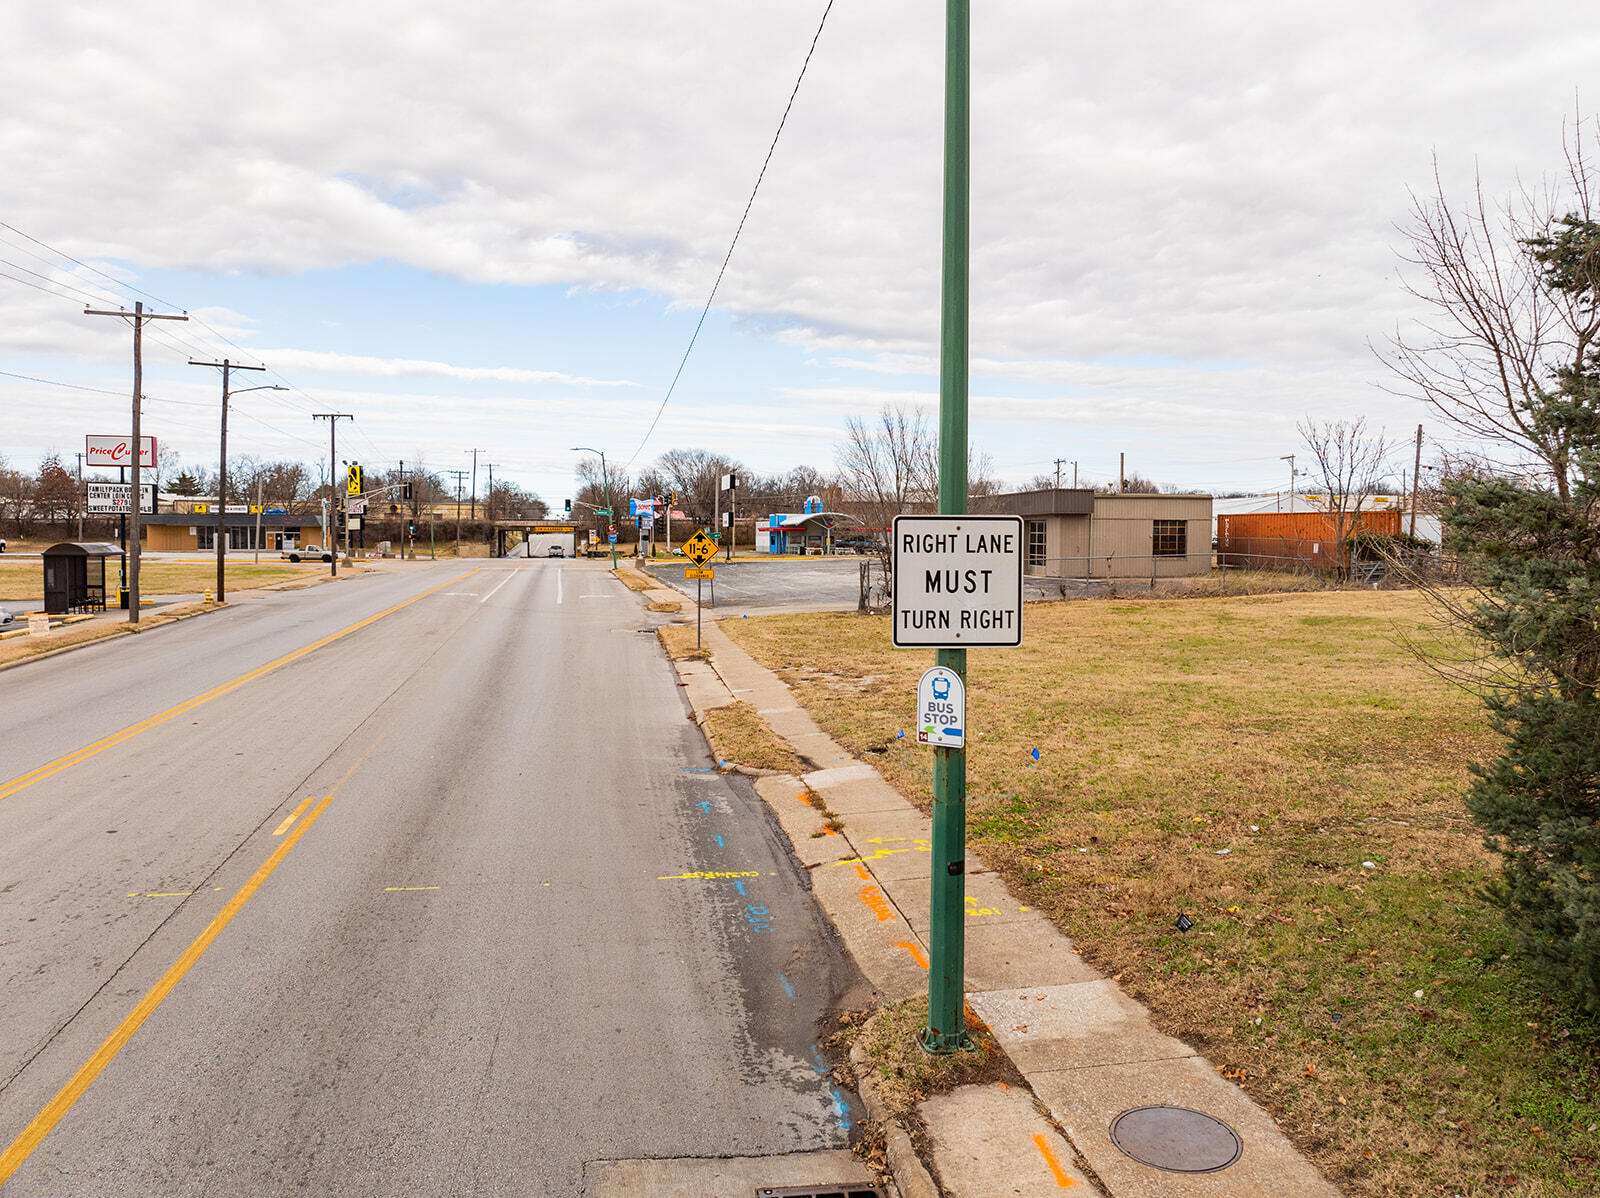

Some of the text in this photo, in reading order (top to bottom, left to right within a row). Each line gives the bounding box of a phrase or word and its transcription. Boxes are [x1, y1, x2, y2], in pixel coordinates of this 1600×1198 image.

[111, 442, 149, 460] Cuer
[903, 534, 1014, 553] RIGHT LANE
[925, 570, 992, 593] MUST
[901, 610, 1014, 629] TURN RIGHT
[928, 701, 954, 714] BUS
[924, 713, 958, 725] STOP
